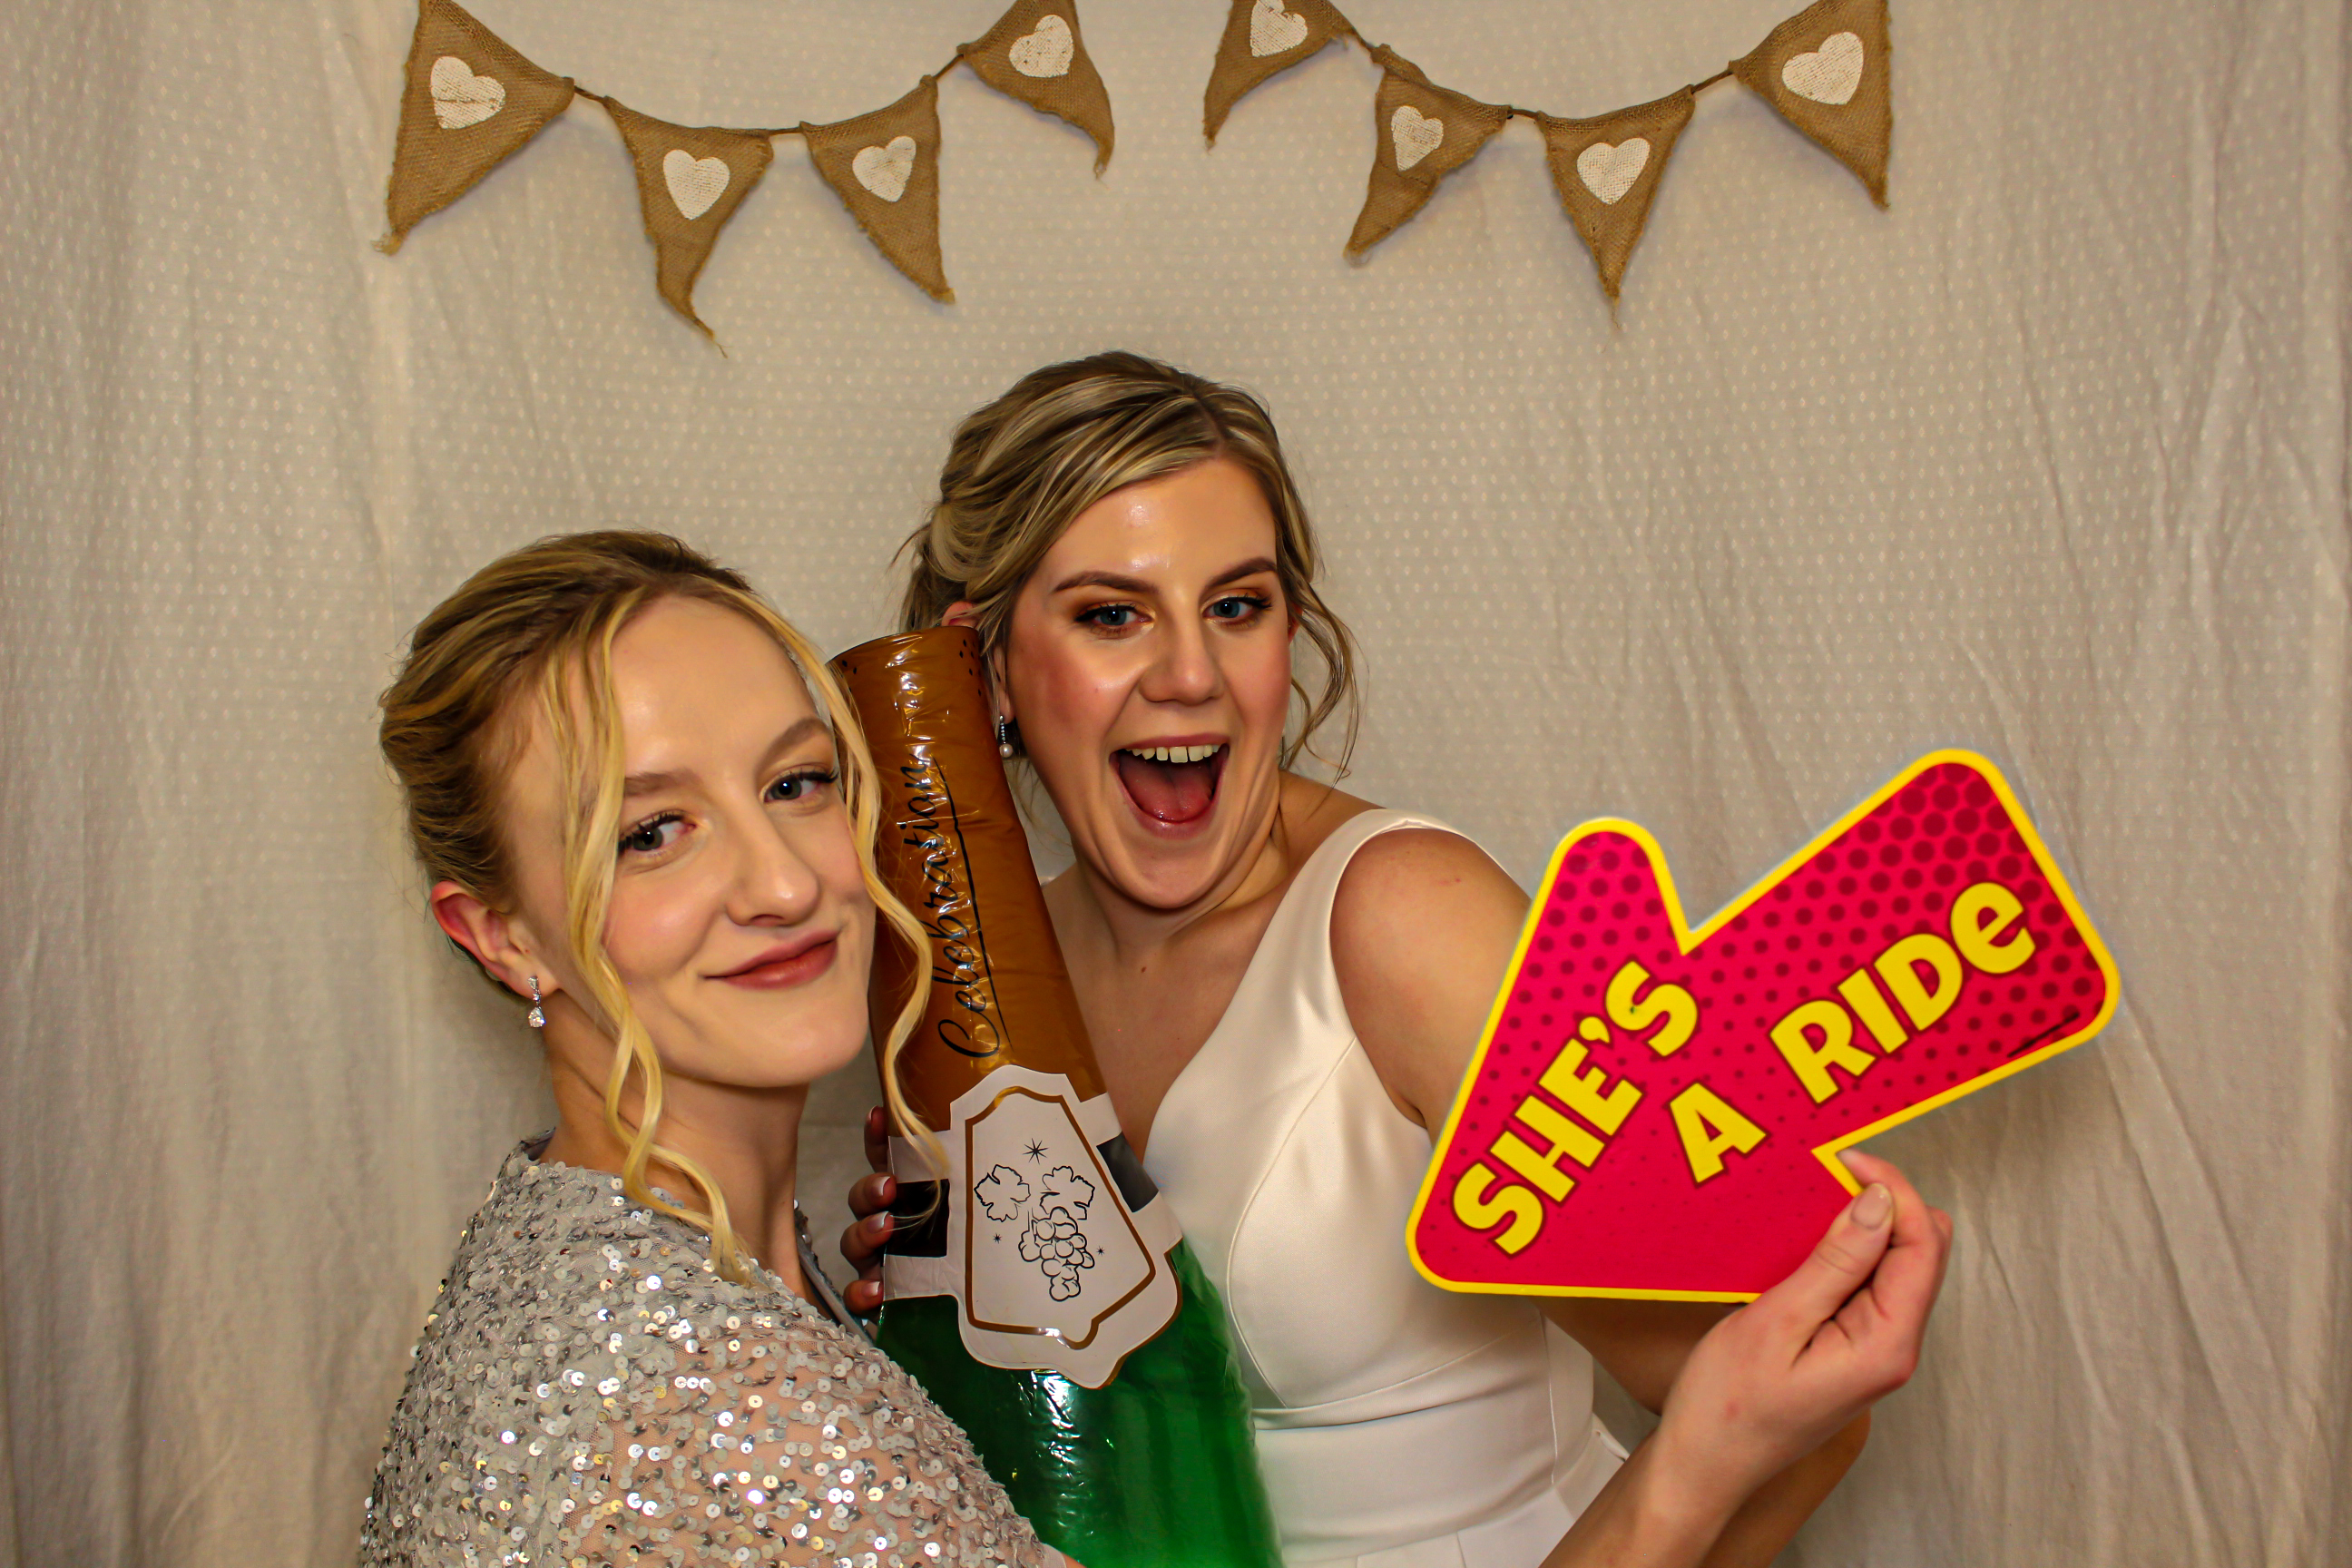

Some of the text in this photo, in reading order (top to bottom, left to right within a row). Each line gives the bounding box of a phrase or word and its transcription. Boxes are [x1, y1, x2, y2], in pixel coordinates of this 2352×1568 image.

[899, 753, 1000, 1058] Celebration
[1453, 960, 1698, 1256] SHE'S
[1669, 1083, 1768, 1184] A
